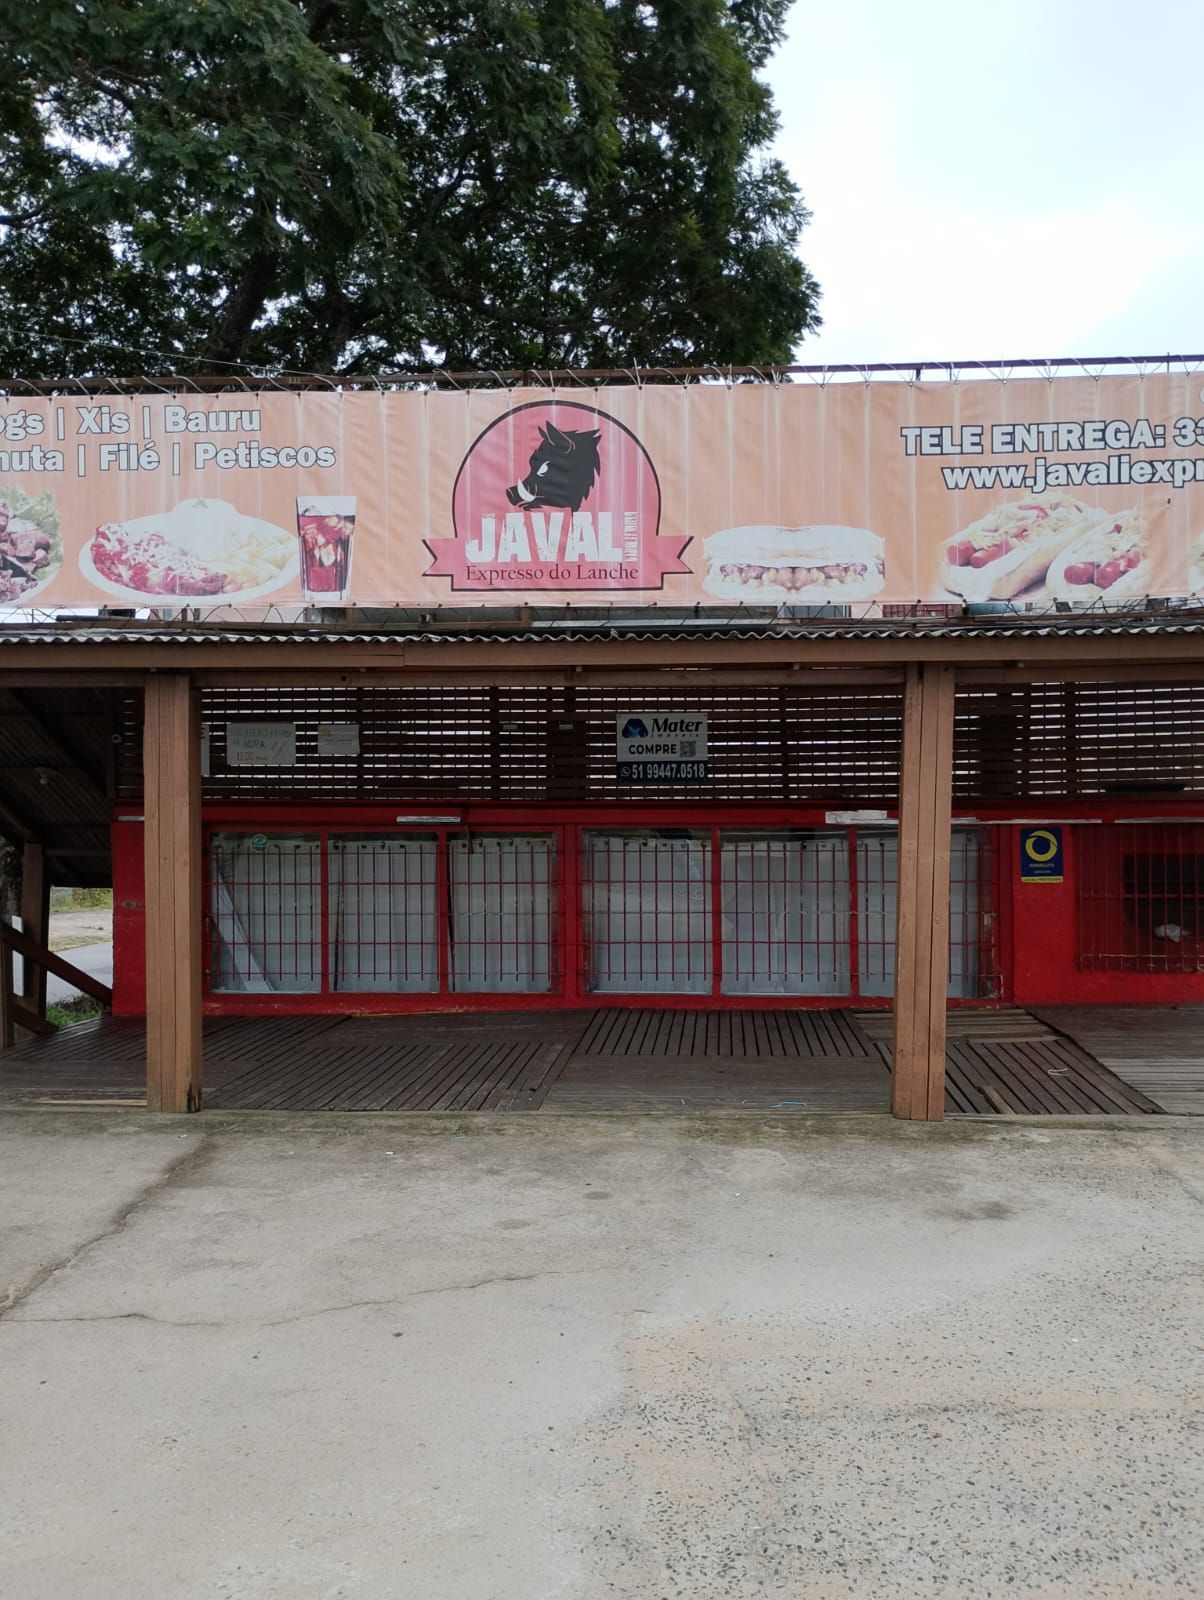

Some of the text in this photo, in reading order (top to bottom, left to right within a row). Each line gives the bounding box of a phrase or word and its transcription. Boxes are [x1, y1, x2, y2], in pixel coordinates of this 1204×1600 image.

[0, 407, 45, 441] gs
[77, 406, 130, 434] Xis
[164, 405, 262, 433] Bauru
[900, 425, 983, 456] TELE
[991, 419, 1167, 454] ENTREGA:
[100, 441, 160, 472] Filé
[195, 441, 337, 470] Petiscos
[465, 562, 639, 586] Expresso do Lanche
[651, 717, 703, 734] Mater
[628, 744, 677, 755] COMPRE
[631, 763, 705, 779] 51 99447.0518
